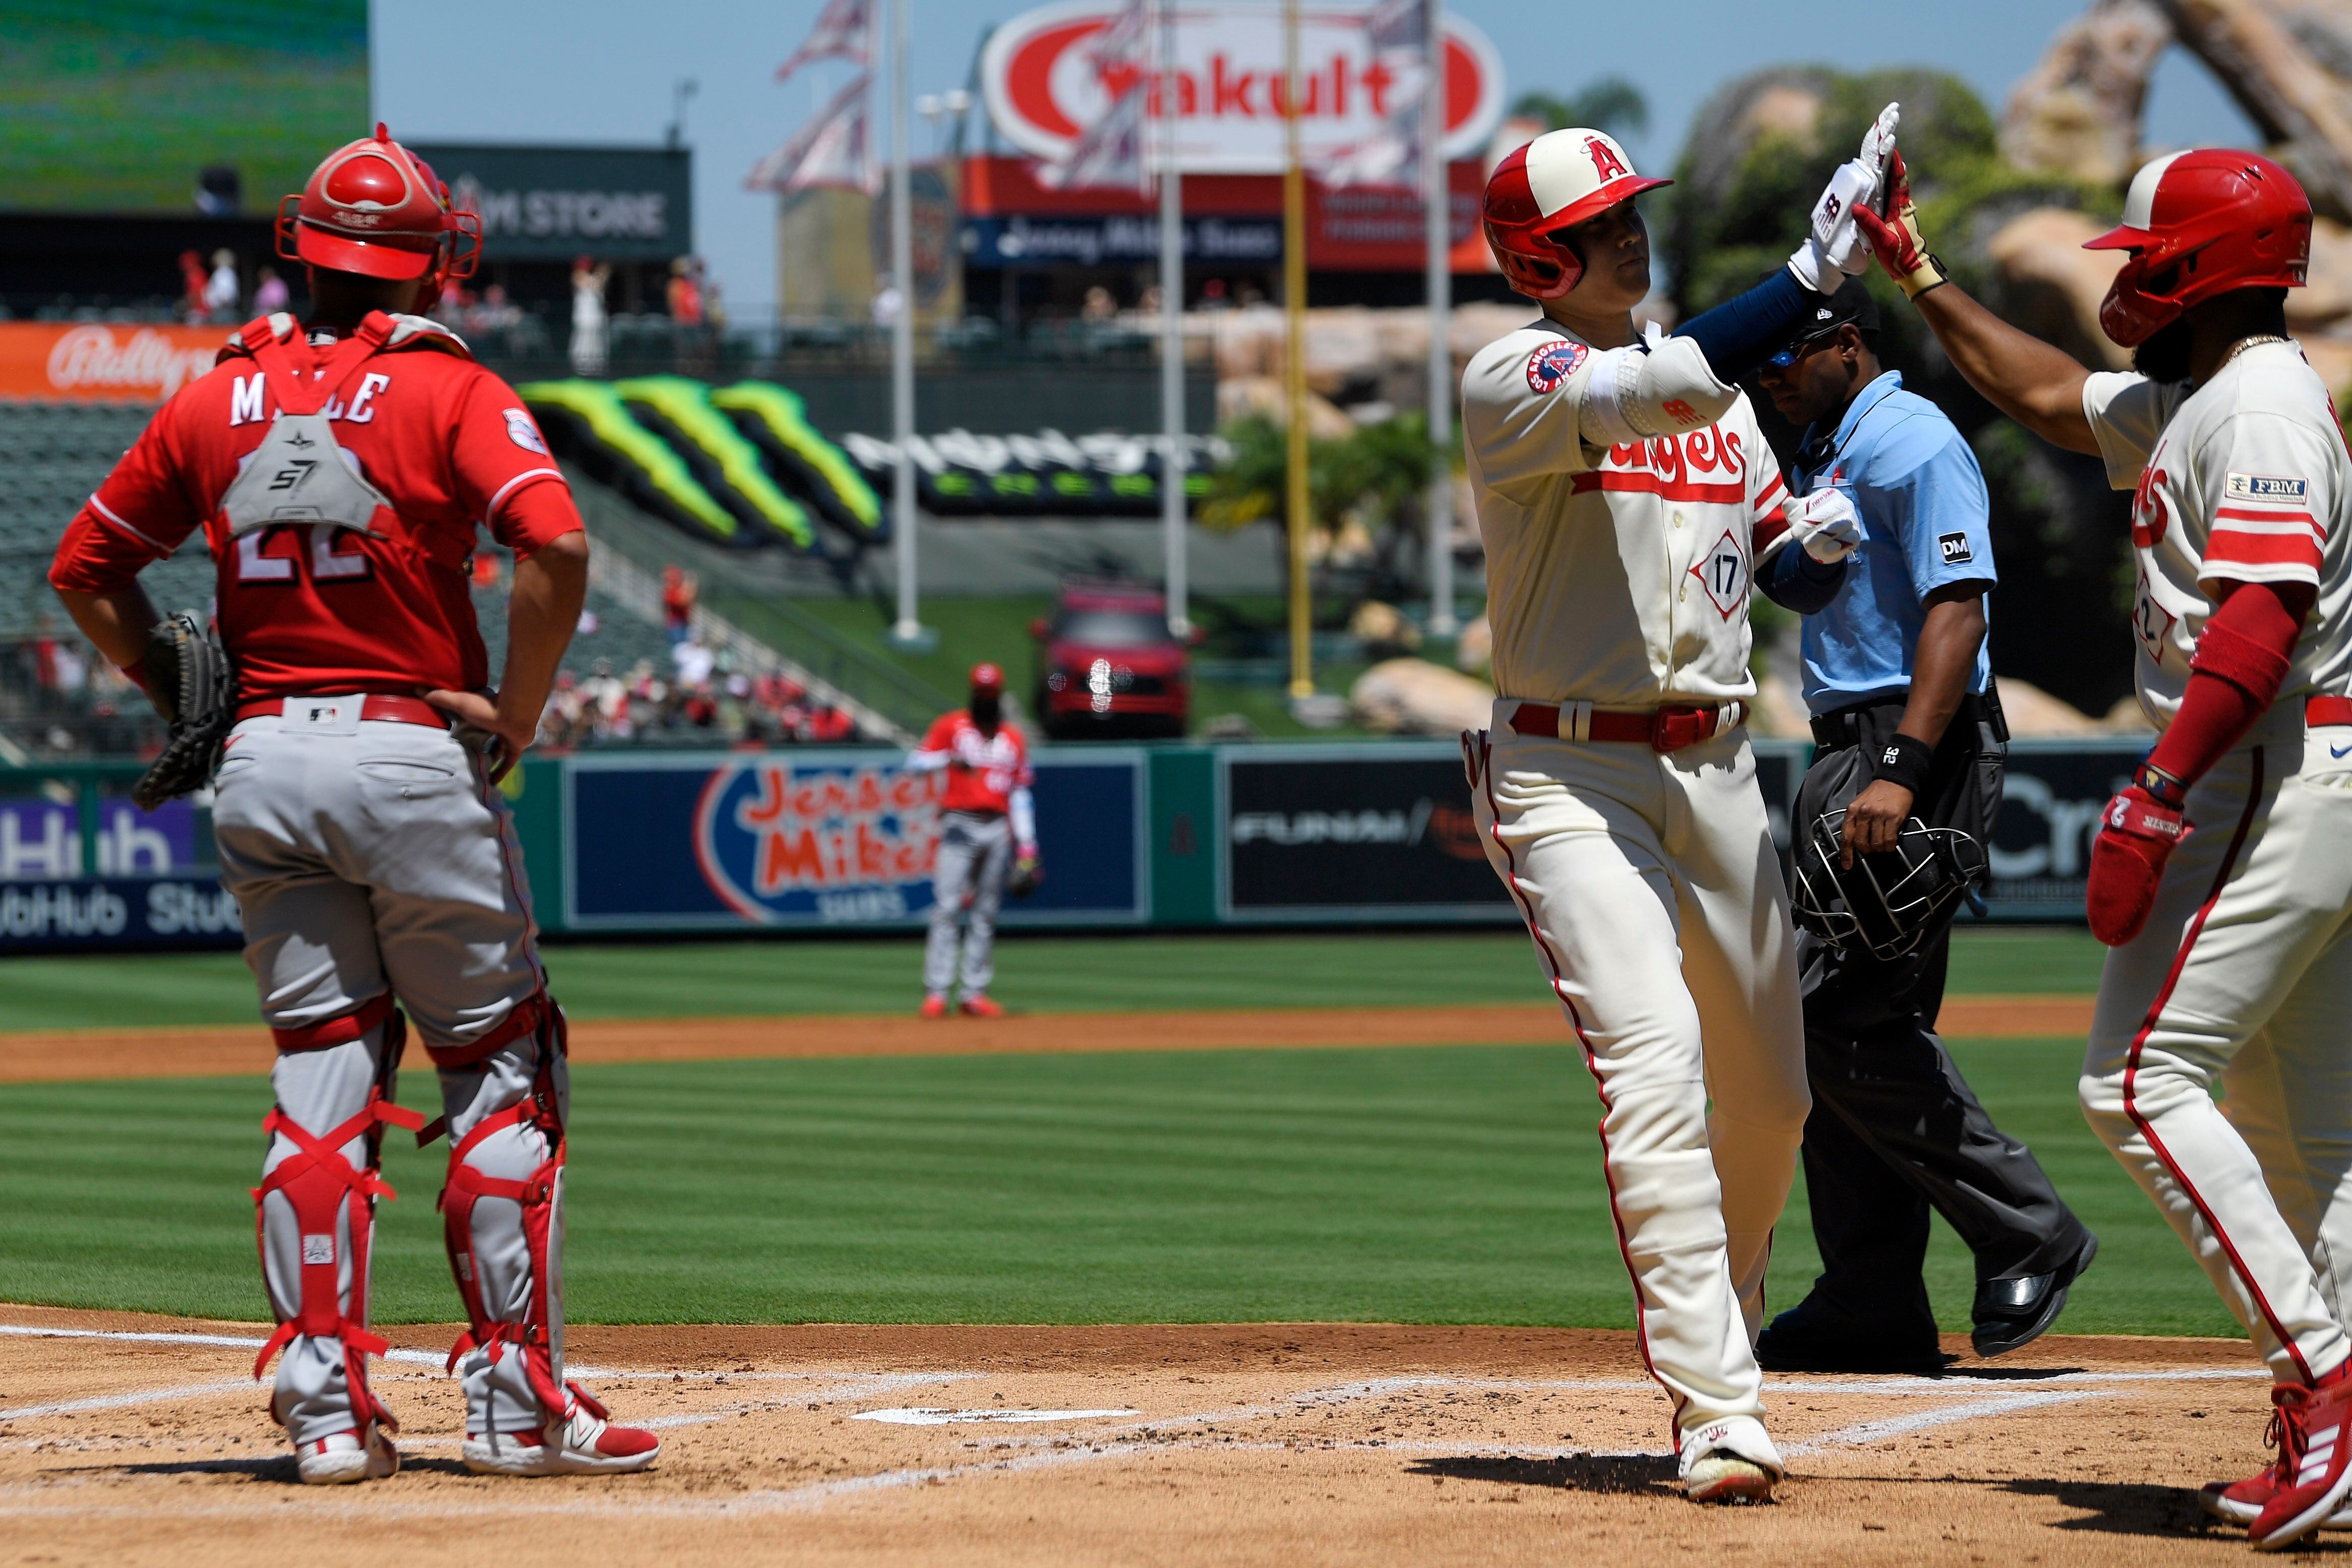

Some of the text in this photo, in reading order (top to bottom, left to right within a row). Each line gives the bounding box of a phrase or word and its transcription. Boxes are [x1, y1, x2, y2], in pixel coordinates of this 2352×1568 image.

[1583, 135, 1628, 185] A
[524, 190, 666, 238] STORE
[1529, 341, 1580, 372] ANGELES
[229, 371, 391, 427] MLE
[2255, 479, 2301, 495] FBM
[1942, 538, 1968, 556] DM
[1715, 554, 1738, 597] 17
[748, 768, 940, 821] Jerse
